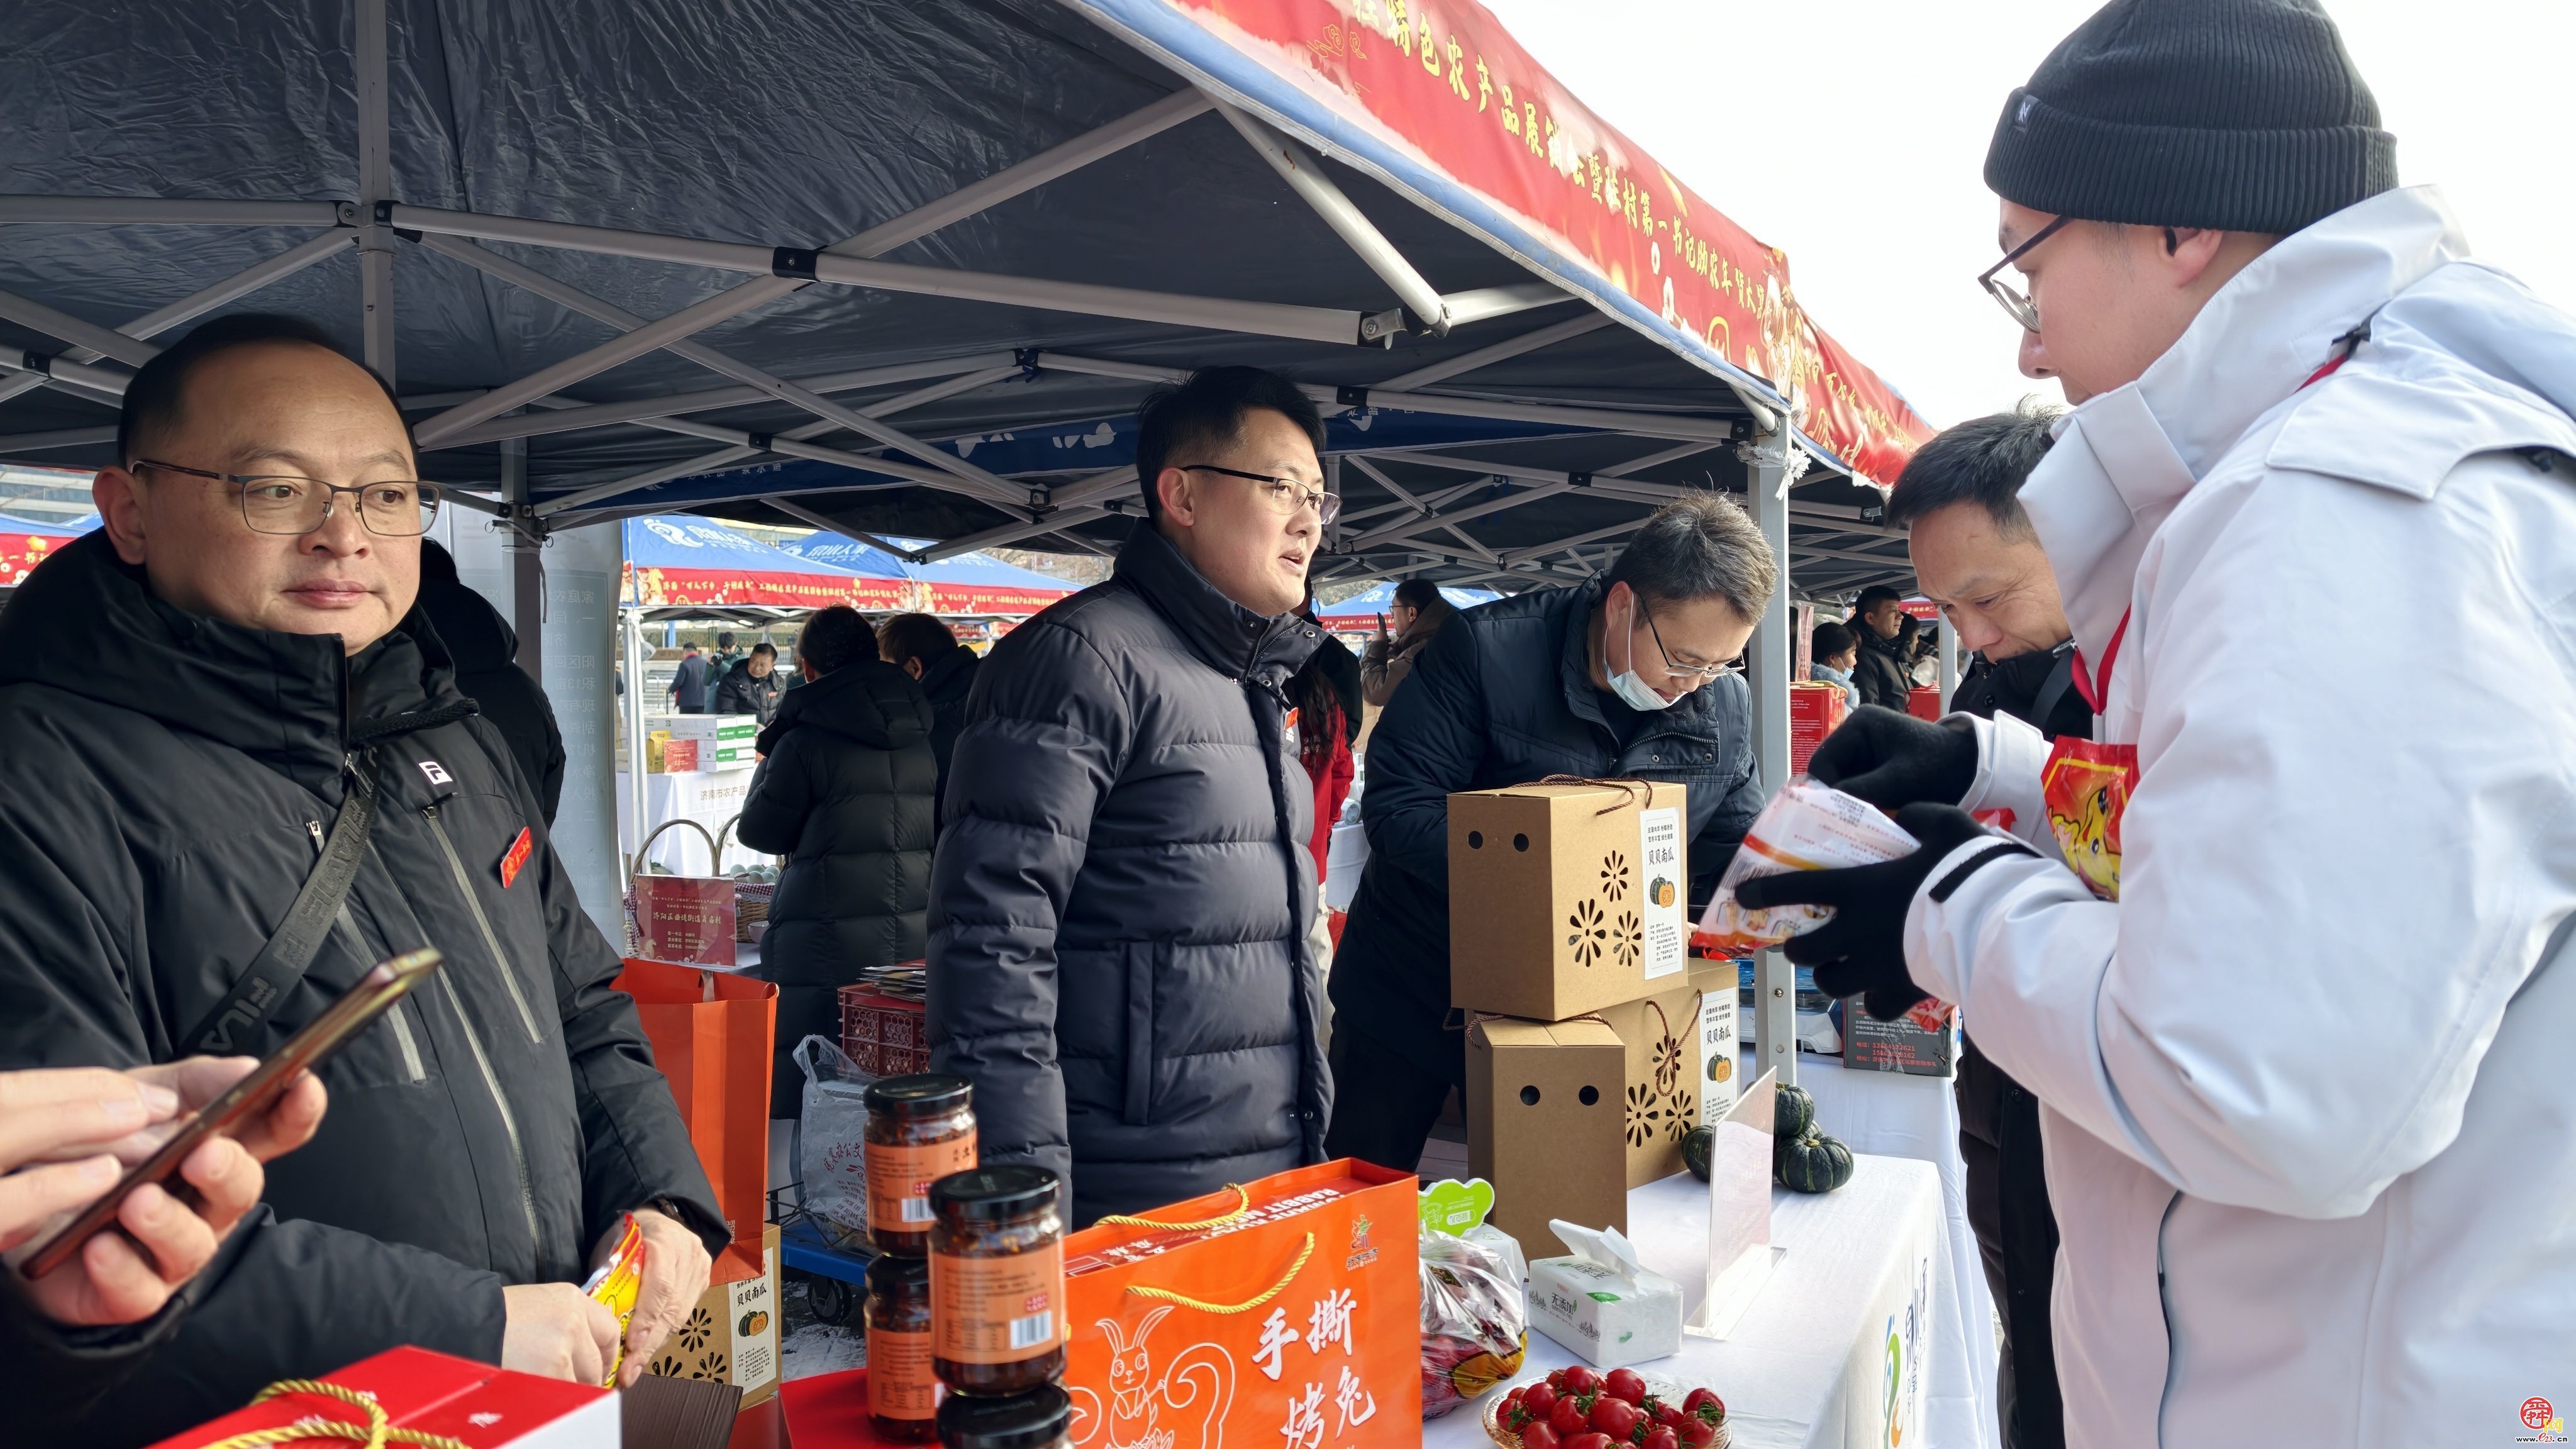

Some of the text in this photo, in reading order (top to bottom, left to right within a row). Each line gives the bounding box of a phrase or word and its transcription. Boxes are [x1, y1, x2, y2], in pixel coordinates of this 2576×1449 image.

[700, 785, 749, 801] 济南市农产品
[1648, 847, 1674, 865] 贝贝南瓜
[1707, 1025, 1731, 1045] 贝贝南瓜
[737, 1283, 767, 1307] 贝贝南瓜
